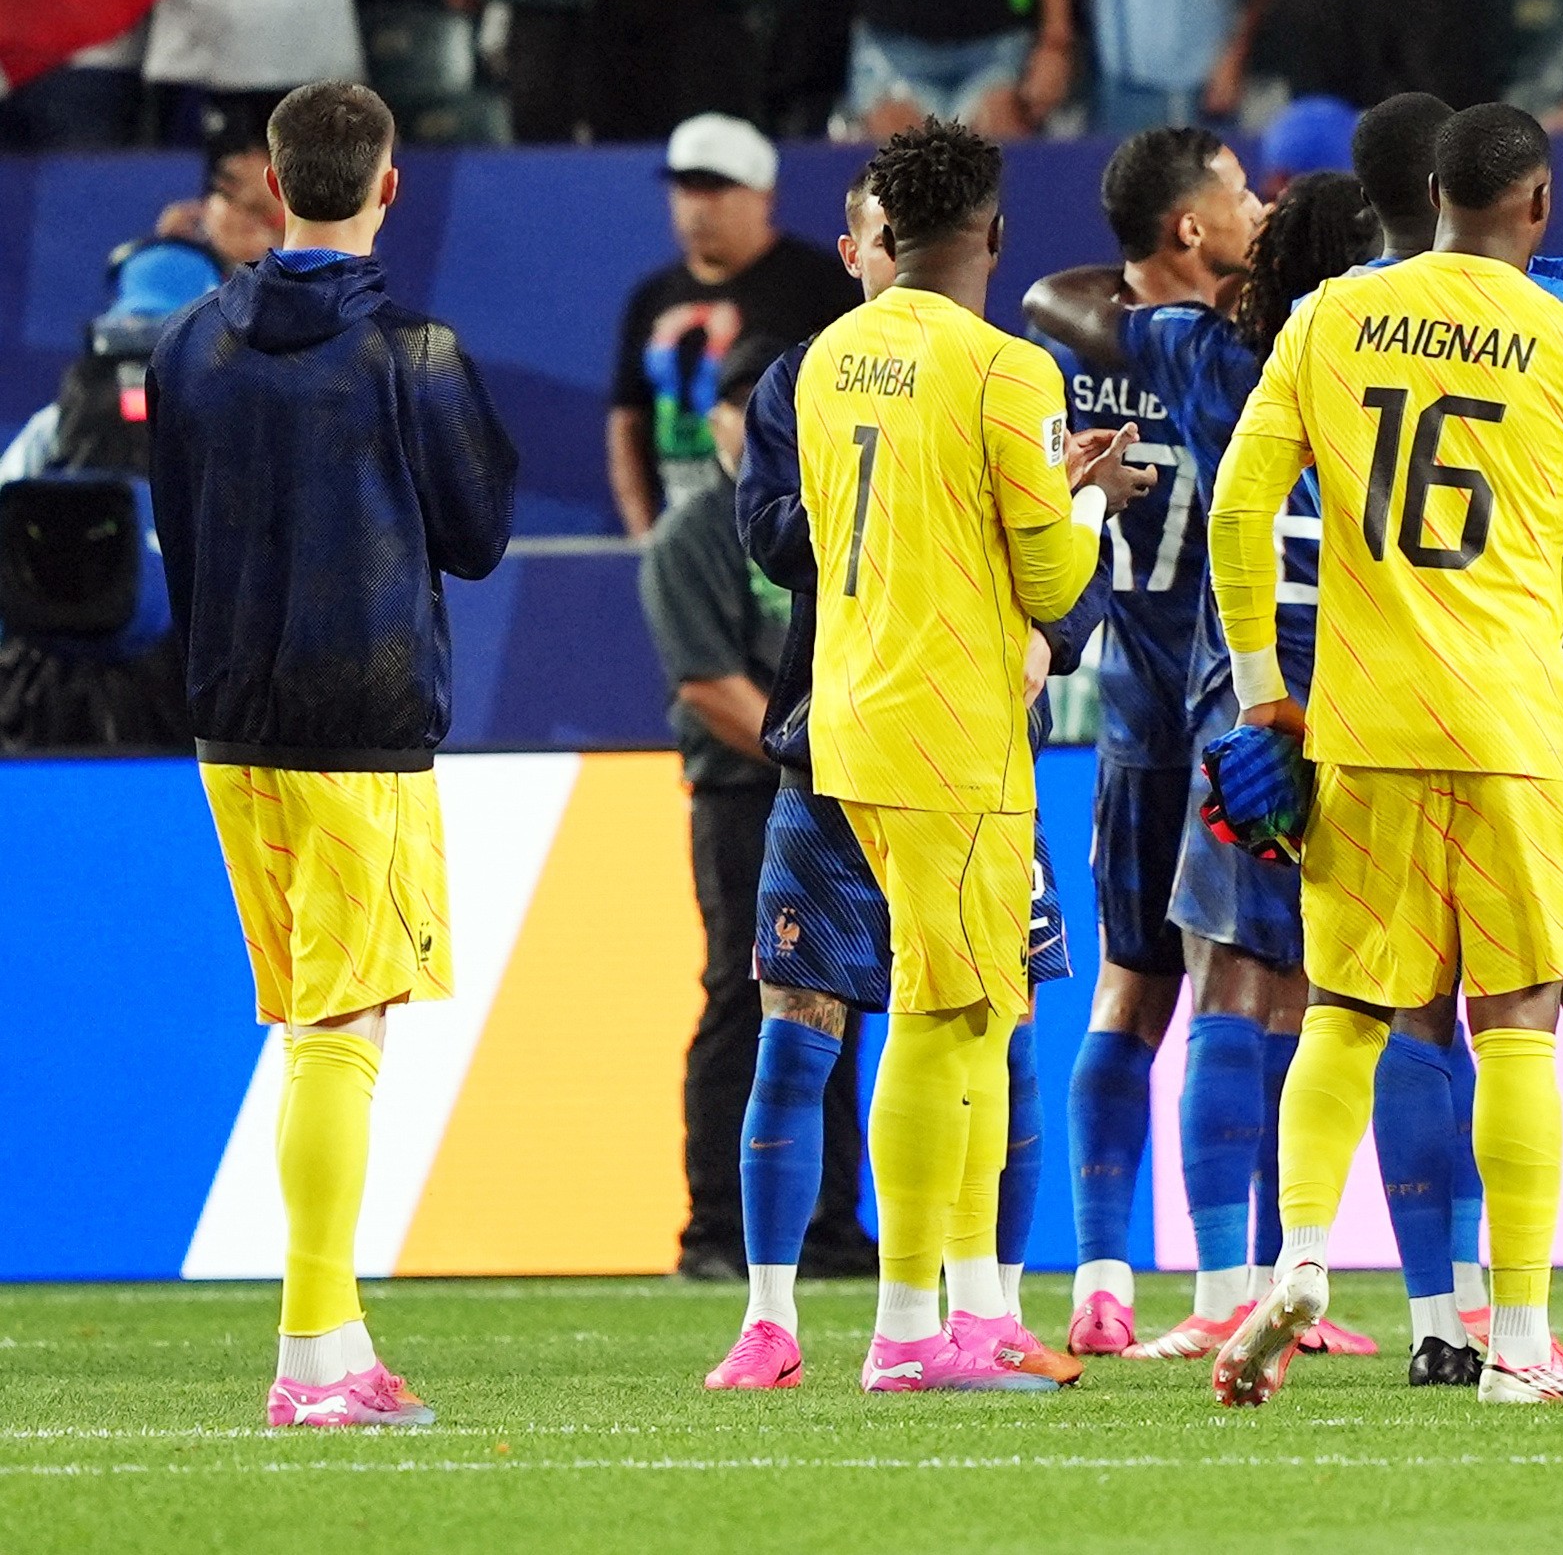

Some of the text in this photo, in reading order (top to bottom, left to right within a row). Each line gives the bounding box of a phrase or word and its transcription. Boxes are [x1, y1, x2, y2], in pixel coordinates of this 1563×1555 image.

[835, 353, 916, 399] SAMBA
[1355, 314, 1536, 374] MAIGNAN
[842, 425, 879, 597] 1
[1361, 386, 1507, 571] 16
